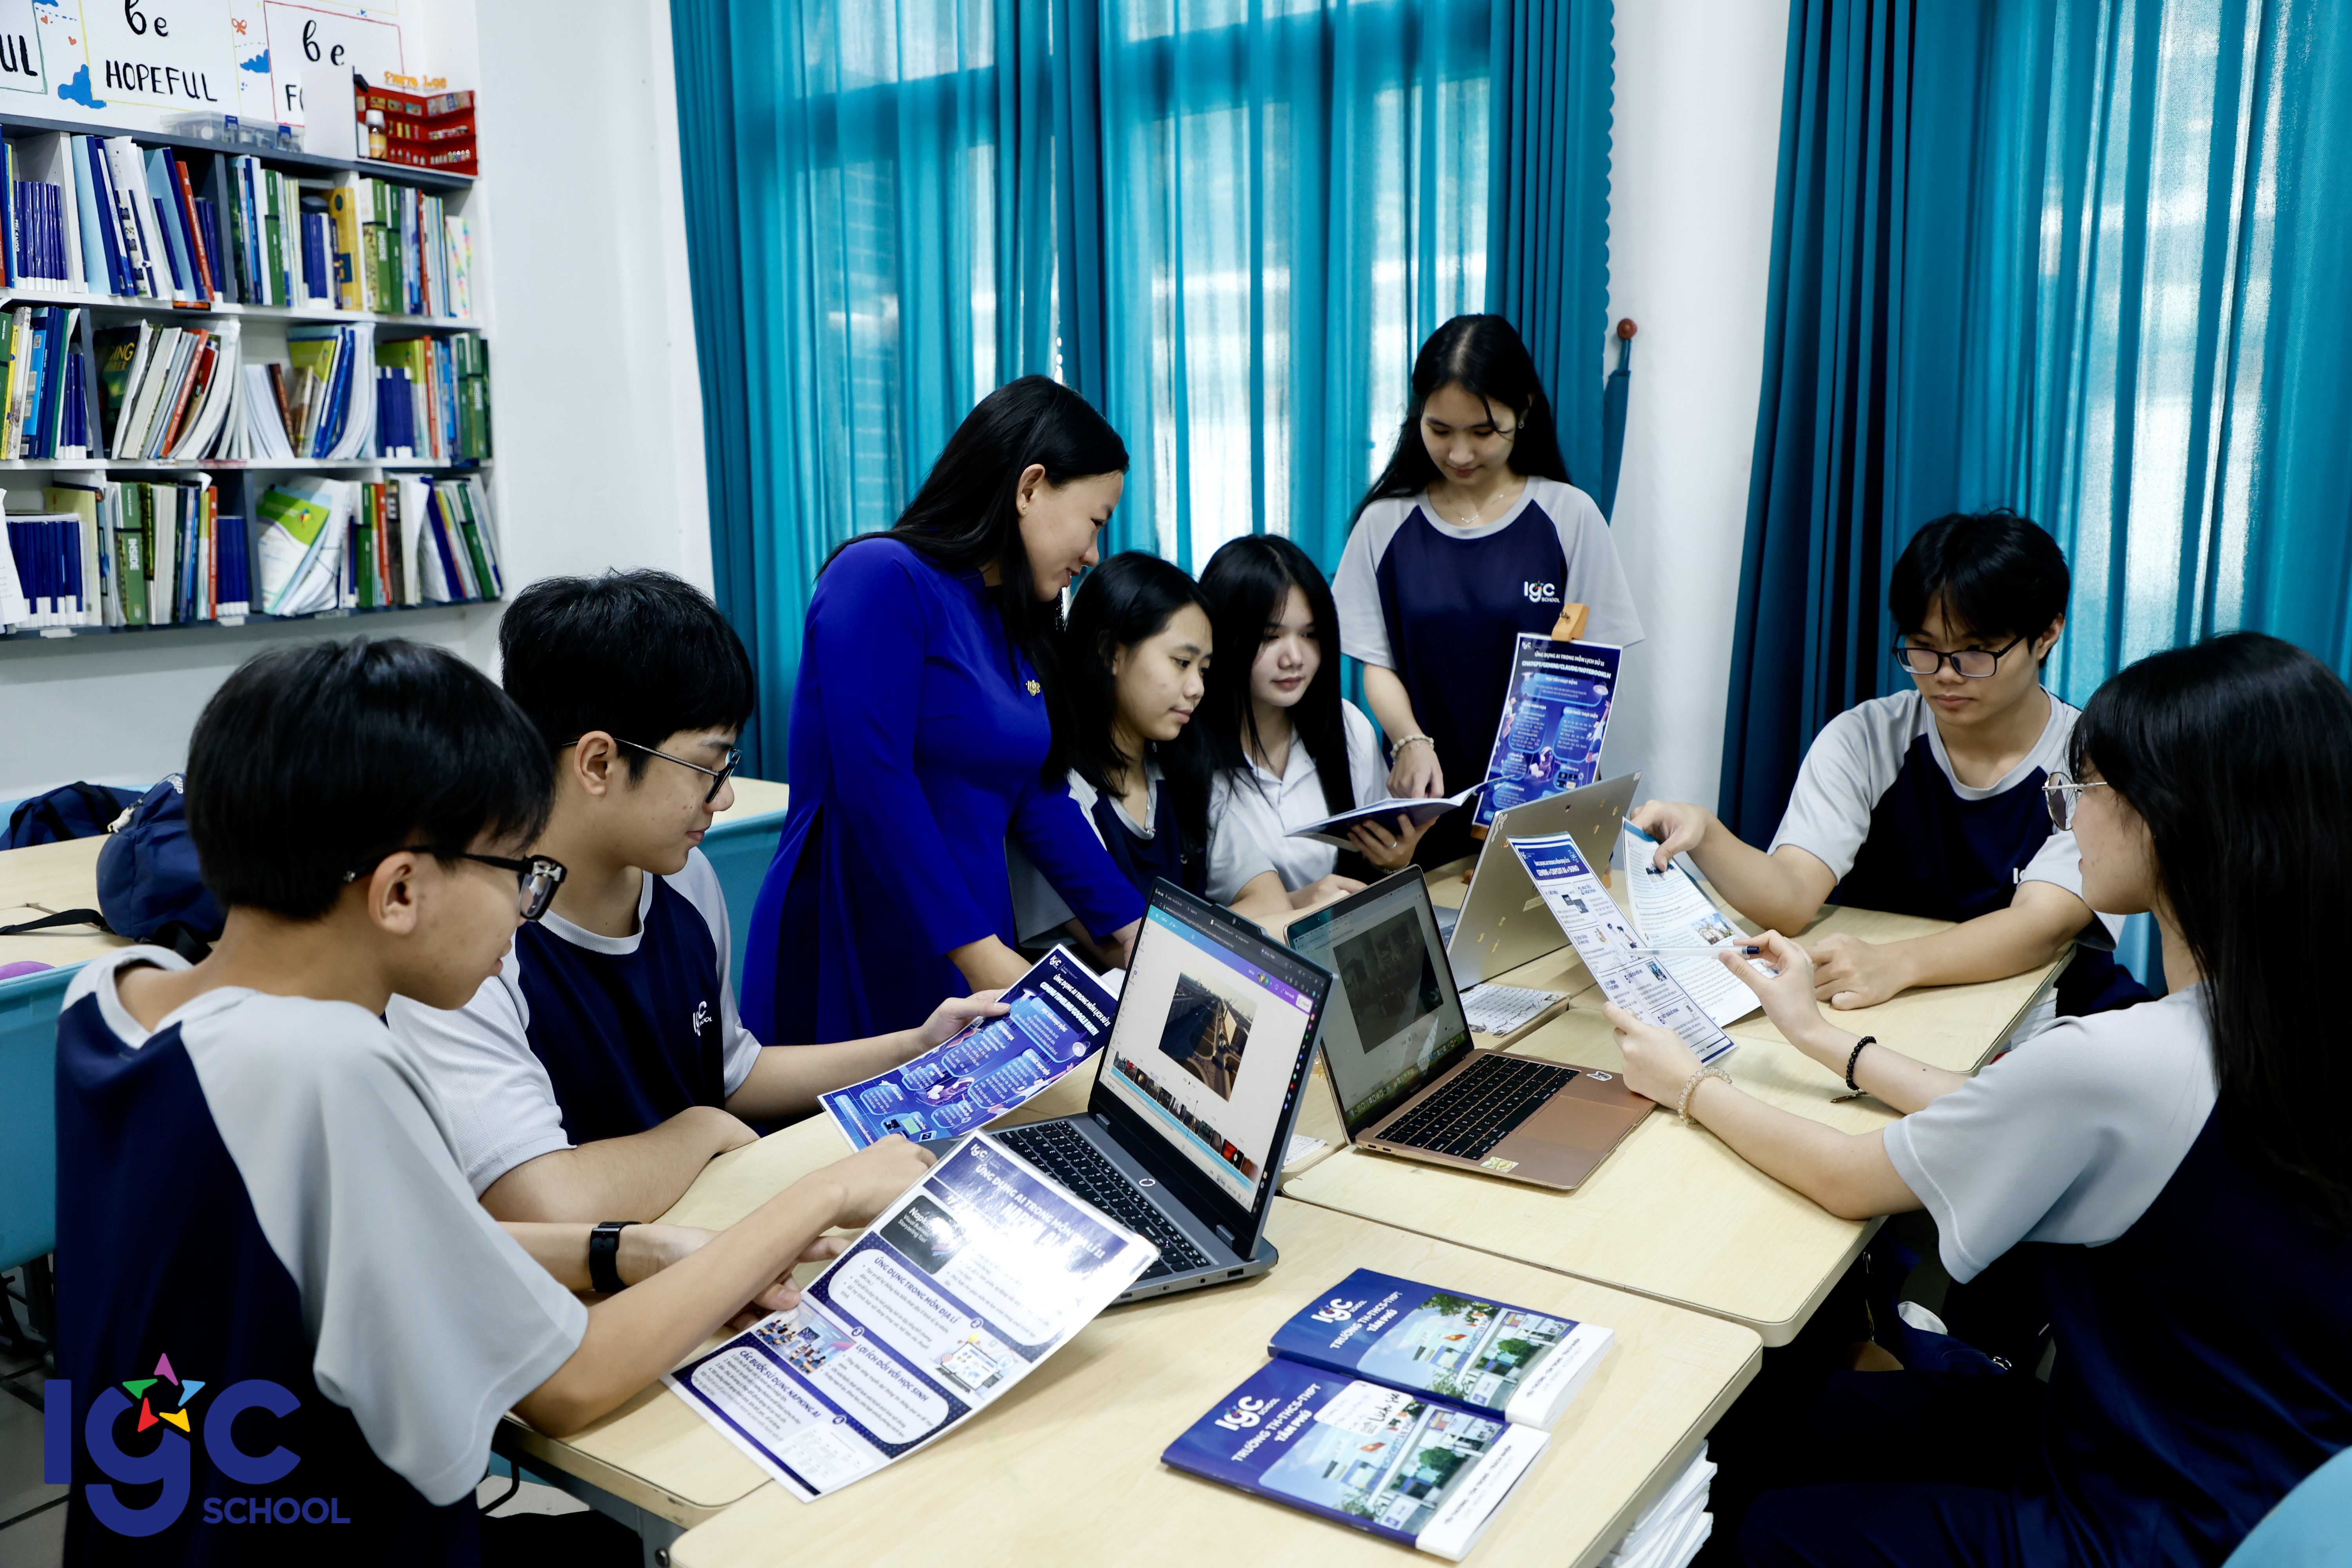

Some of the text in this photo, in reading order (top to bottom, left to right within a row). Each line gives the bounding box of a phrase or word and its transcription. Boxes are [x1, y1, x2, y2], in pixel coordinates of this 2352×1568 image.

[105, 60, 218, 102] HOPEFUL
[127, 538, 140, 570] INSIDE
[1041, 982, 1087, 1023] GEMINI/TIMELINE/GOOGLE
[1084, 1022, 1098, 1035] EARTH
[1053, 974, 1063, 983] ỨNG
[1061, 981, 1073, 991] DỤNG
[1075, 992, 1088, 1004] TRONG
[1086, 1002, 1098, 1012] MÔN
[898, 1219, 920, 1238] Storytelling
[975, 1163, 994, 1180] ỨNG
[993, 1178, 1016, 1196] DỤNG
[1014, 1194, 1026, 1203] AI
[1025, 1200, 1053, 1222] TRONG
[1051, 1219, 1074, 1236] MÔN
[1094, 1248, 1105, 1258] 11
[875, 1257, 889, 1270] ỨNG
[887, 1268, 905, 1283] DỤNG
[905, 1282, 925, 1299] TRONG
[924, 1297, 939, 1310] MÔN
[939, 1308, 951, 1318] ĐỊA
[1329, 1291, 1403, 1348] TRƯỜNG TH-THCS-THPT
[1366, 1308, 1398, 1332] TÂN PHÚ
[740, 1351, 752, 1360] CÁC
[749, 1359, 766, 1372] BƯỚC
[771, 1377, 789, 1391] DỤNG
[789, 1390, 813, 1412] NAPKING
[856, 1345, 928, 1400] LỢI ÍCH ĐỐI VỚI HỌC SINH
[1231, 1383, 1321, 1462] TRƯỜNG TH-THCS-THPT
[1258, 1397, 1281, 1416] SCHOOL
[1274, 1409, 1313, 1442] TÂN PHÚ
